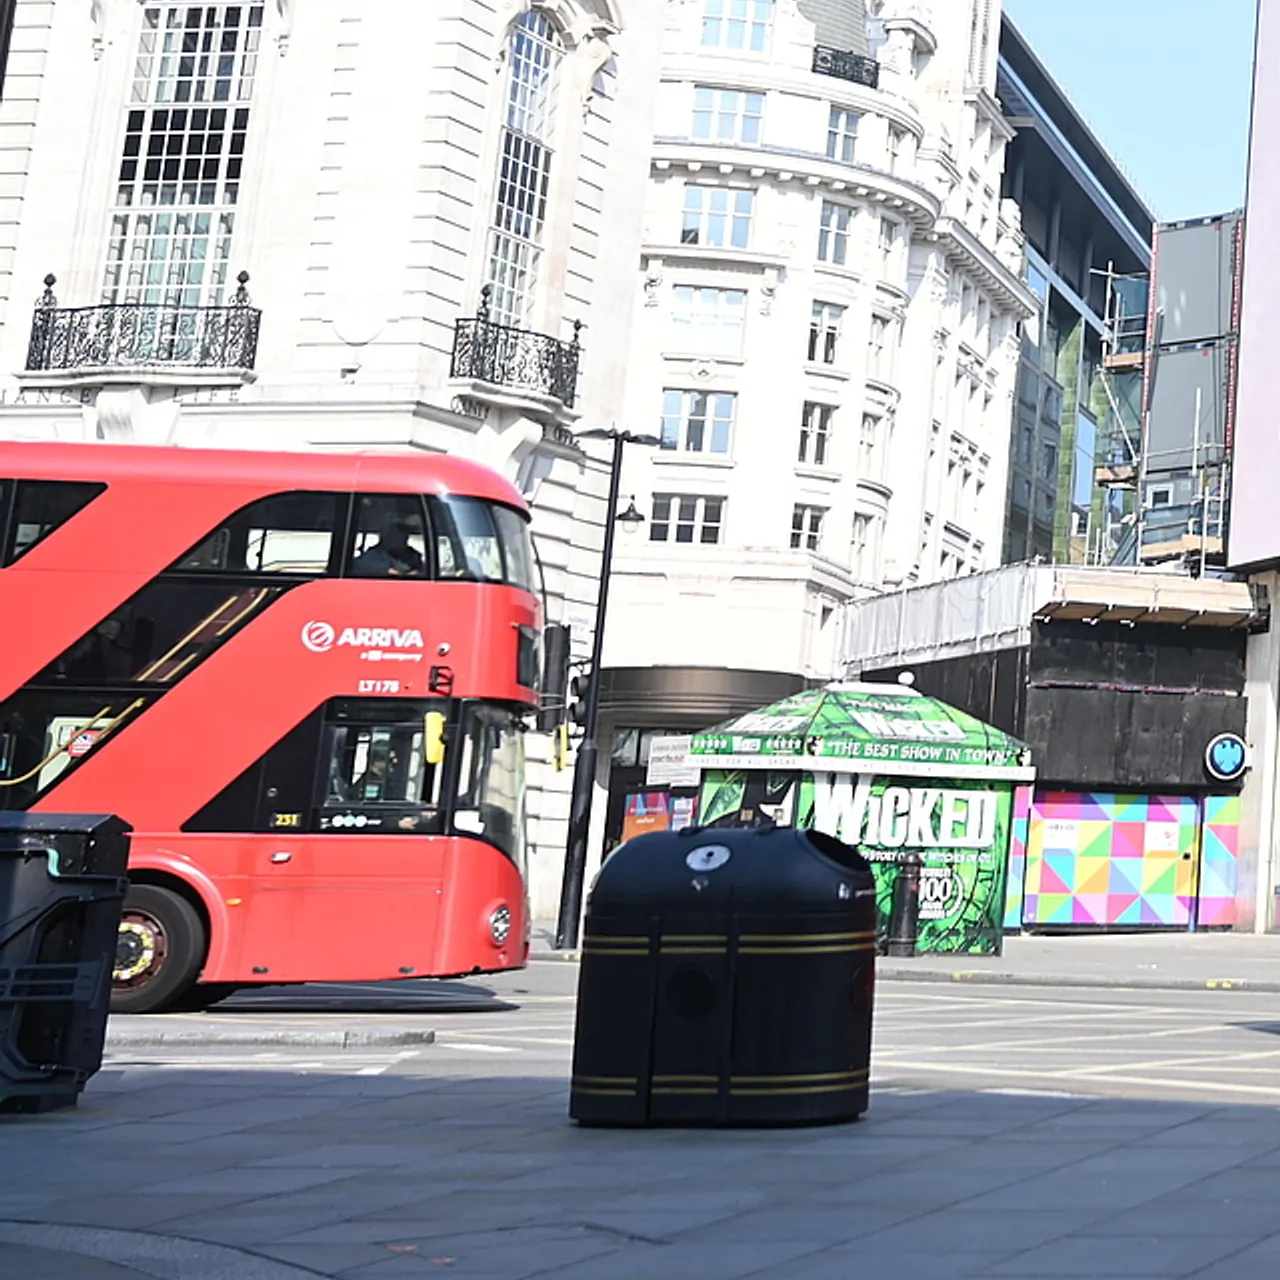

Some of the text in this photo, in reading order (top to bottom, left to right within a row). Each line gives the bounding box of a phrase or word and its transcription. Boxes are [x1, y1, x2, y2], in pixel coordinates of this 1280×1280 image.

[337, 628, 424, 648] ARRIVA
[864, 744, 899, 758] BEST
[901, 746, 944, 760] SHOW
[945, 748, 961, 760] IN
[918, 878, 952, 902] 100
